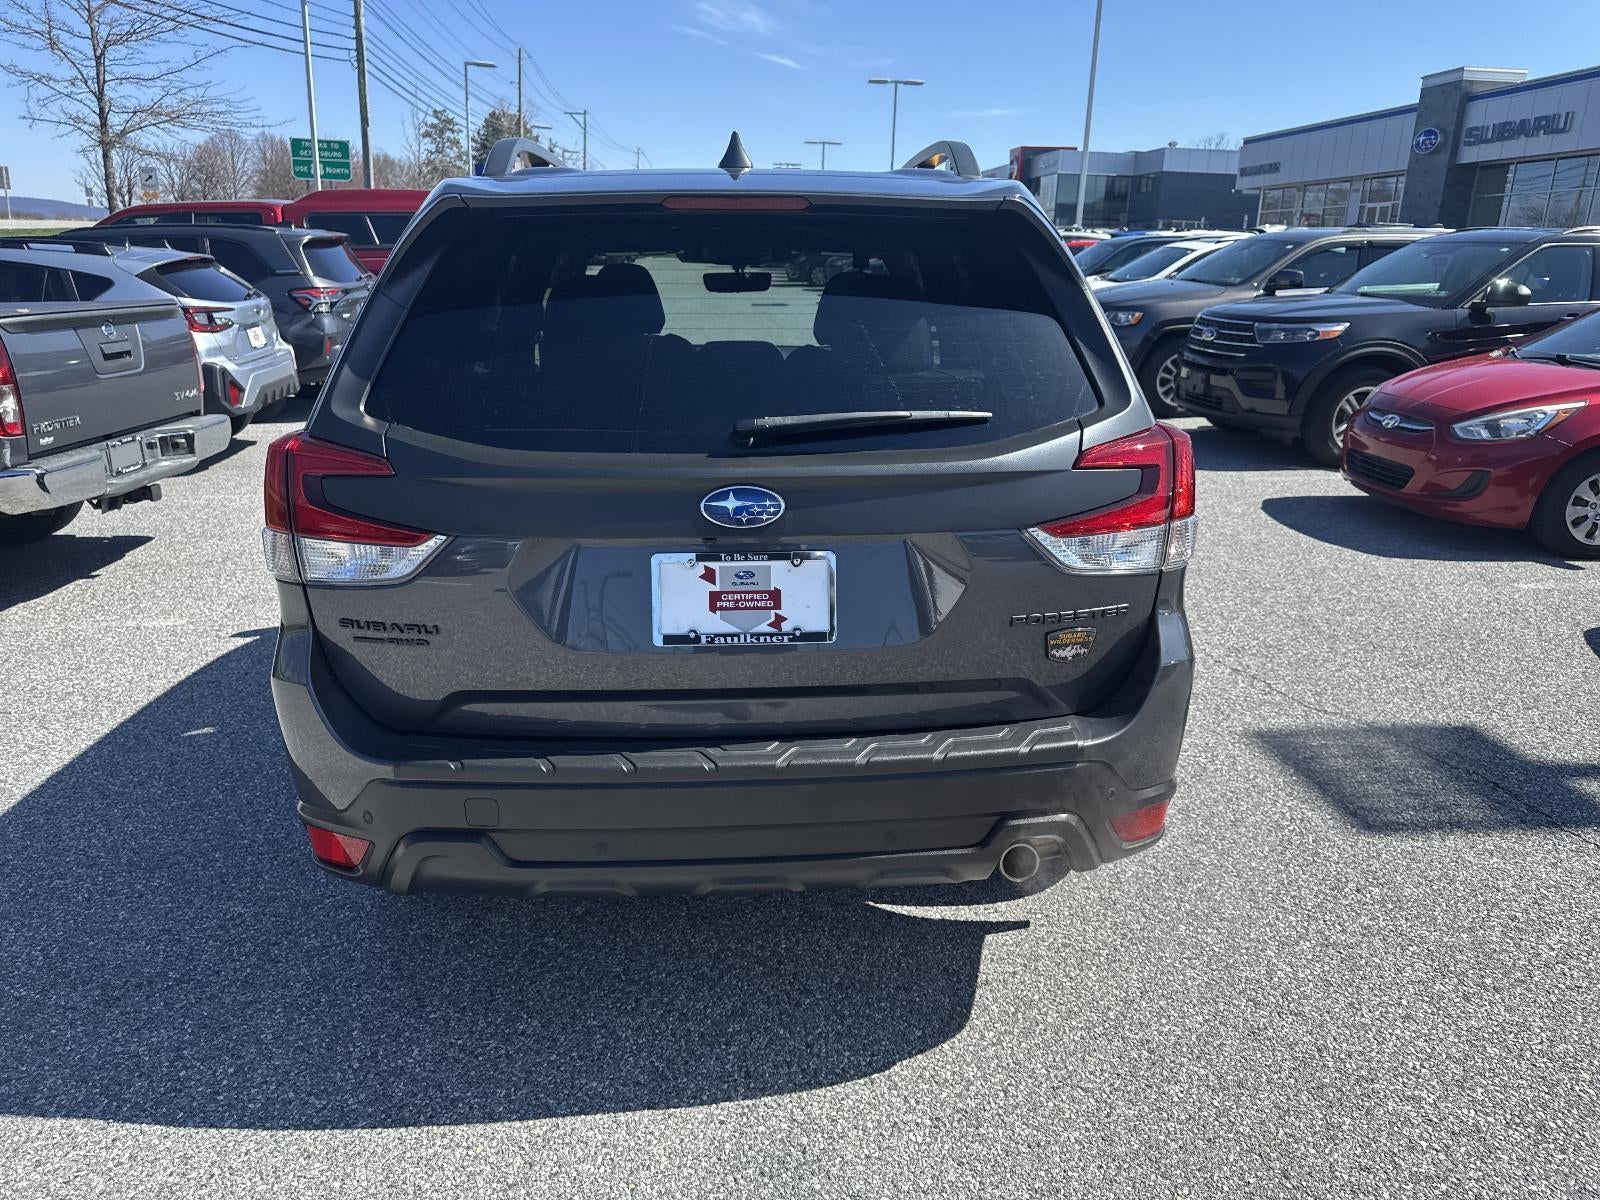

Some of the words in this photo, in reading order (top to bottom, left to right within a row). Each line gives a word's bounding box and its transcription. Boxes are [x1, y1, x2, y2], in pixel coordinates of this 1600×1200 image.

[1463, 111, 1575, 147] SUBARU
[299, 150, 343, 158] GETSBURG
[294, 165, 309, 173] USE
[325, 166, 350, 175] NORTH
[32, 416, 82, 435] FRONTIER
[720, 553, 731, 561] To
[733, 553, 746, 561] Be
[747, 553, 769, 561] Sure
[721, 593, 770, 601] CERTIFIED
[716, 600, 774, 608] PRE-OWNED
[1009, 603, 1130, 627] FORESTER
[338, 617, 439, 635] SUBARU
[699, 633, 794, 645] Faulkner
[1058, 632, 1088, 641] SUBARU
